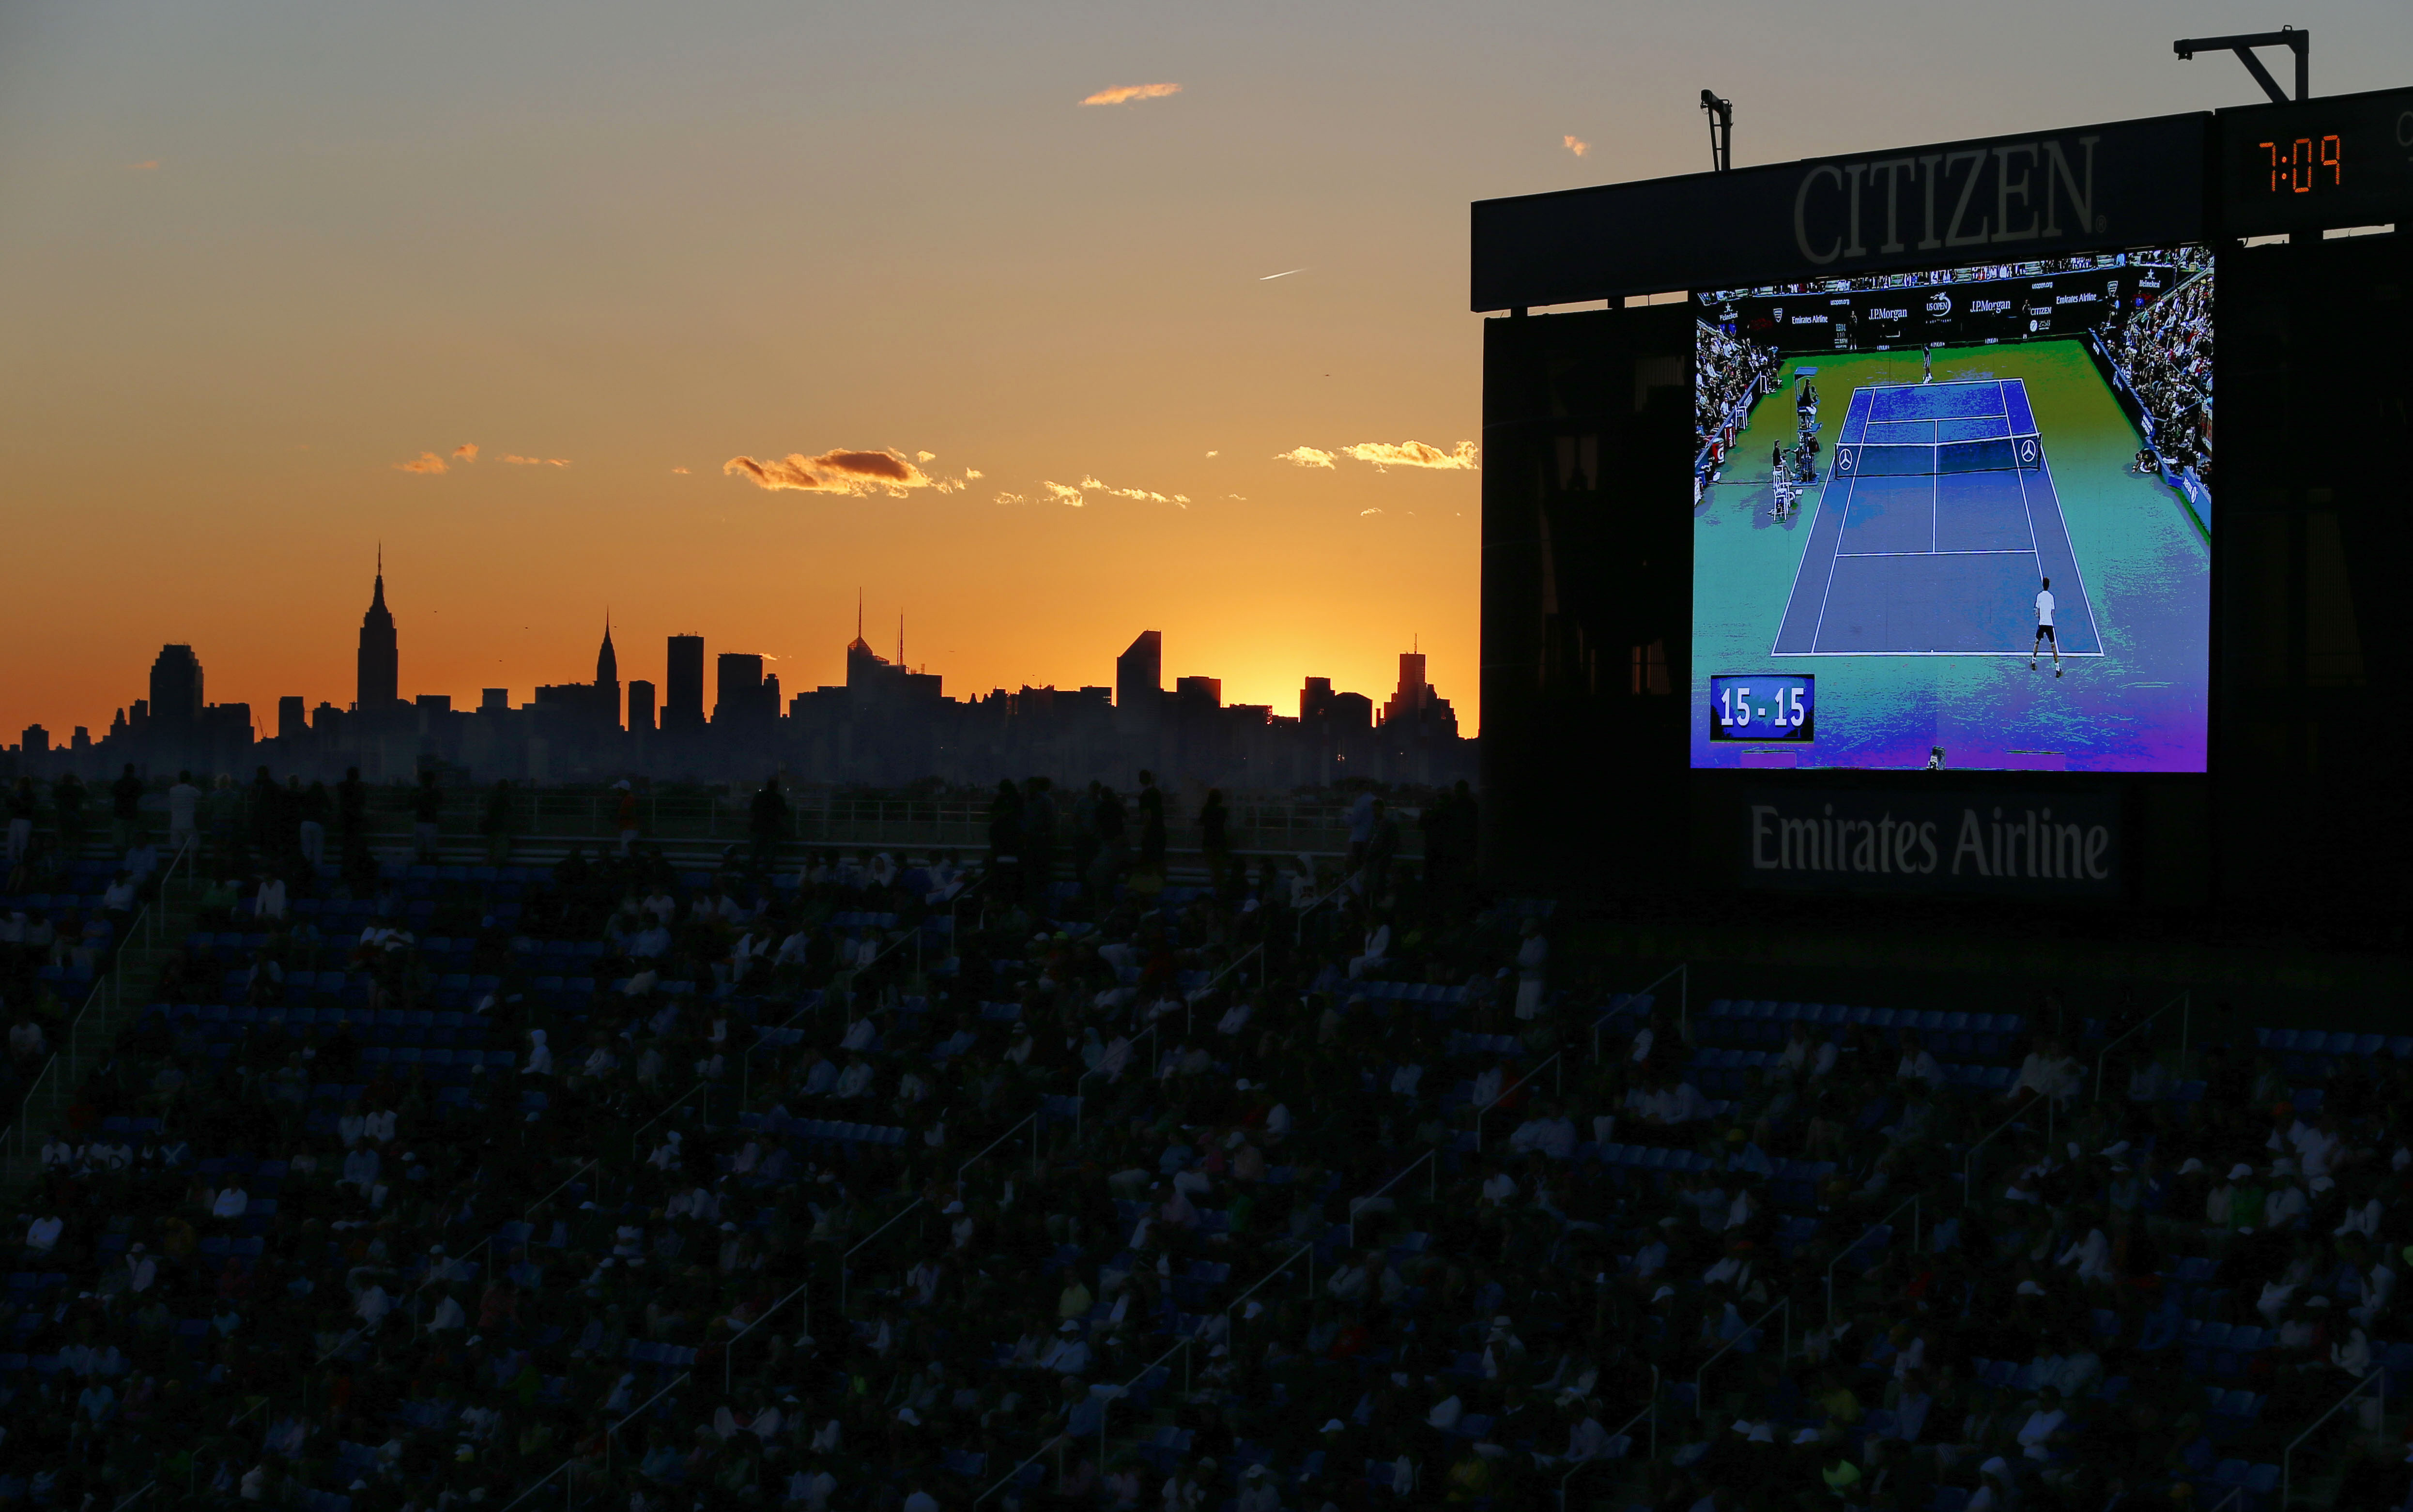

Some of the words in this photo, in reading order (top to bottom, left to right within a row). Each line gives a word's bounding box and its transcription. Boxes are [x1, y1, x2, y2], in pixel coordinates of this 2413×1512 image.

[2259, 135, 2340, 193] 7:09
[1794, 136, 2100, 264] CITIZEN
[2032, 281, 2053, 290] usopen.org
[2139, 279, 2160, 288] Heineken
[2057, 295, 2078, 305] Emirates
[2079, 293, 2096, 302] Airline
[1927, 303, 1933, 311] US
[1934, 302, 1948, 310] OPEN
[2030, 306, 2051, 316] CITIZEN
[1720, 310, 1737, 321] Heineken
[1792, 315, 1811, 324] Emirates
[1812, 315, 1828, 323] Airline
[1836, 323, 1846, 332] IBM
[1717, 447, 1724, 459] G
[1721, 687, 1750, 726] 15
[1775, 687, 1804, 726] 15
[1751, 803, 1937, 873] Emirates
[1952, 806, 2108, 880] Airline
